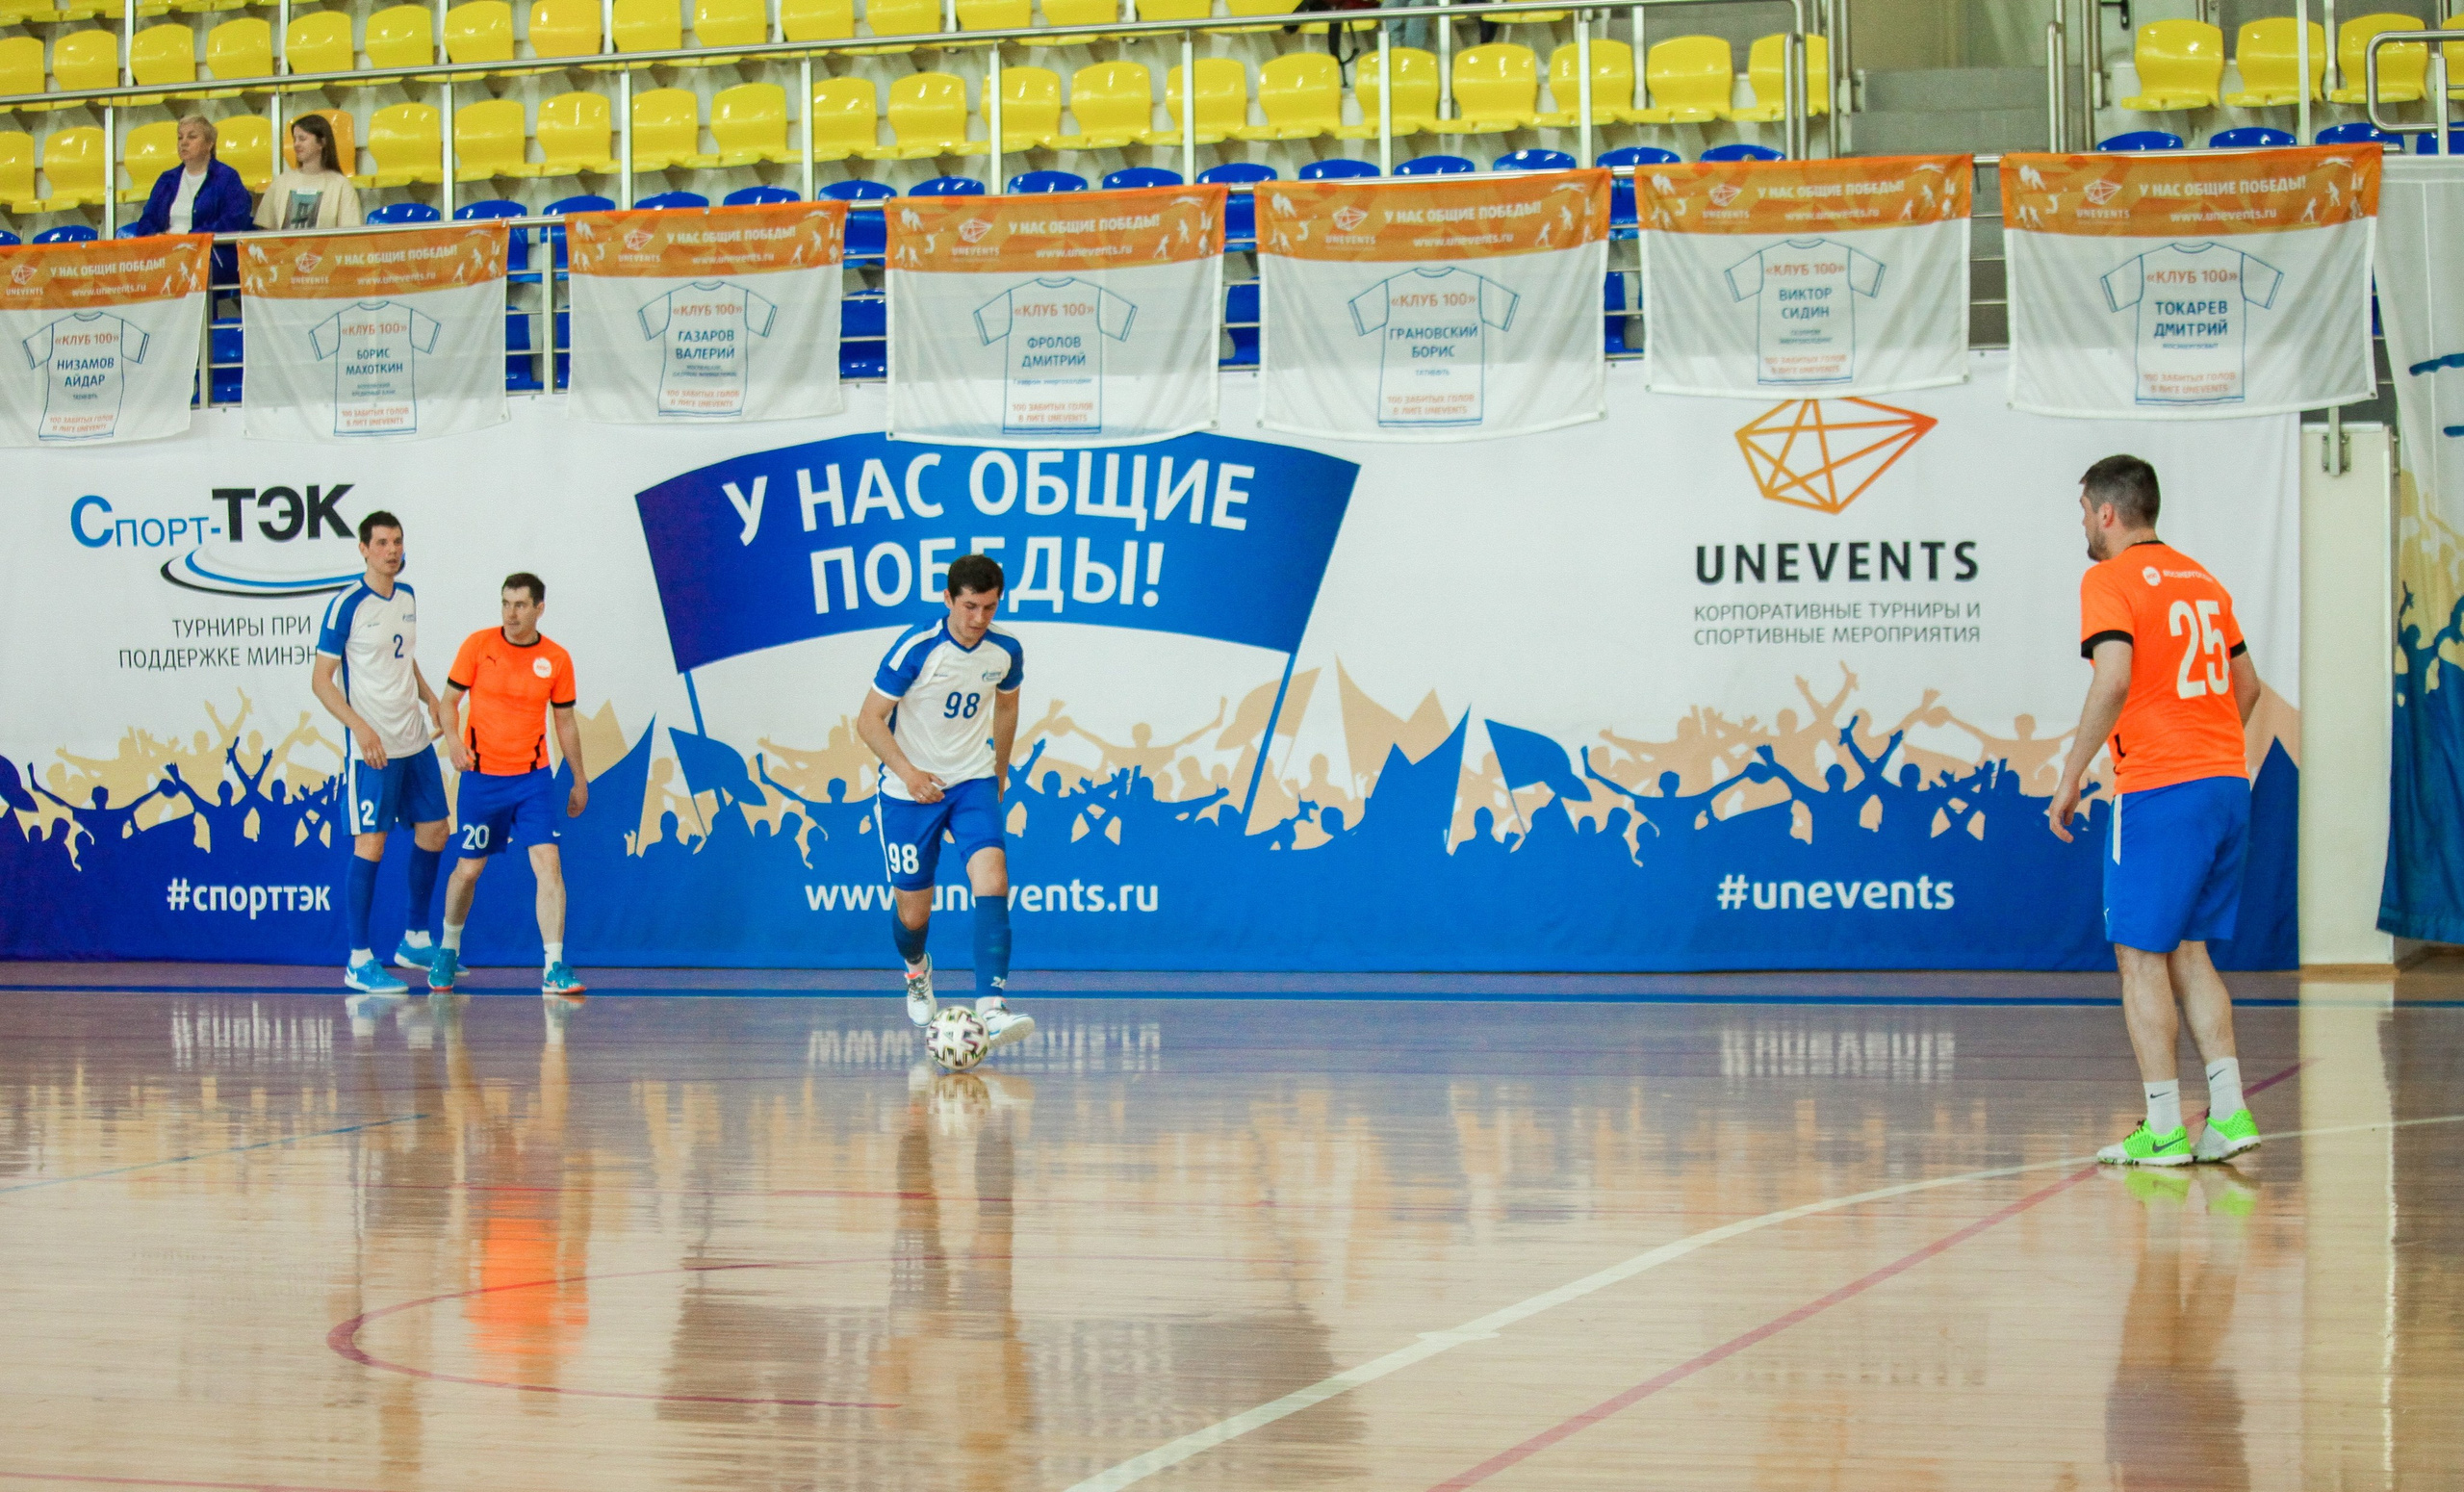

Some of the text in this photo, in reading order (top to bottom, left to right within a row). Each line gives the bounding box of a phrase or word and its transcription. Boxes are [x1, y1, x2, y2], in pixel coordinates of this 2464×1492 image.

[1758, 188, 1766, 198] У
[1769, 187, 1794, 198] НАС
[1797, 185, 1841, 198] ОБЩИЕ
[2139, 176, 2307, 197] У НАС ОБЩИЕ ПОБЕДЫ!
[1385, 201, 1542, 223] У НАС ОБЩИЕ ПОБЕДЫ!
[2076, 209, 2130, 219] UNEVENTS
[2170, 208, 2276, 222] www.unevents.ru
[1010, 214, 1160, 234] У НАС ОБЩИЕ ПОБЕДЫ!
[667, 225, 796, 244] У НАС ОБЩИЕ ПОБЕДЫ!
[1325, 235, 1375, 244] UNEVENTS
[1414, 234, 1514, 247] www.unevents.ru
[335, 244, 457, 266] У НАС ОБЩИЕ ПОБЕДЫ!
[952, 246, 1000, 256] UNEVENTS
[1036, 245, 1132, 258] www.unevents.ru
[618, 254, 660, 263] UNEVENTS
[692, 253, 775, 265] www.unevents.ru
[50, 258, 166, 277] У НАС ОБЩИЕ ПОБЕДЫ!
[1765, 263, 1845, 275] «КЛУБ 100»
[291, 275, 329, 285] UNEVENTS
[357, 272, 436, 285] www.unevents.ru
[2146, 270, 2238, 284] «КЛУБ 100»
[6, 287, 43, 296] UNEVENTS
[72, 284, 146, 296] www.unevents.ru
[1779, 287, 1833, 301] ВИКТОР
[1391, 293, 1476, 307] «КЛУБ 100»
[673, 303, 742, 316] «КЛУБ 100»
[1014, 303, 1094, 317] «КЛУБ 100»
[1782, 306, 1830, 320] СИДИН
[2155, 300, 2228, 316] ТОКАРЕВ
[342, 322, 407, 336] «КЛУБ 100»
[679, 330, 734, 342] ГАЗАРОВ
[1390, 323, 1478, 340] ГРАНОВСКИЙ
[2154, 319, 2228, 339] ДМИТРИЙ
[57, 332, 119, 346] «КЛУБ 100»
[1027, 336, 1081, 348] ФРОЛОВ
[357, 348, 390, 360] БОРИС
[676, 345, 734, 360] ВАЛЕРИЙ
[1412, 346, 1455, 358] БОРИС
[57, 357, 115, 371] НИЗАМОВ
[1022, 352, 1086, 369] ДМИТРИЙ
[346, 363, 403, 375] МАХОТКИН
[64, 373, 106, 388] АЙДАР
[723, 450, 1255, 546] У НАС ОБЩИЕ
[1695, 540, 1980, 585] UNEVENTS
[1694, 601, 1981, 623] КОРПОРАТИВНЫЕ ТУРНИРЫ И
[172, 616, 312, 638] ТУРНИРЫ ПРИ
[1693, 625, 1981, 647] СПОРТИВНЫЕ МЕРОПРИЯТИЯ
[393, 633, 404, 659] 2
[2169, 600, 2230, 700] 25
[117, 646, 241, 670] ПОДДЕРЖКЕ
[943, 691, 981, 719] 98
[360, 801, 375, 827] 2
[461, 823, 490, 851] 20
[887, 842, 920, 875] 98
[166, 876, 331, 920] #спорттэк
[1717, 873, 1955, 911] #unevents
